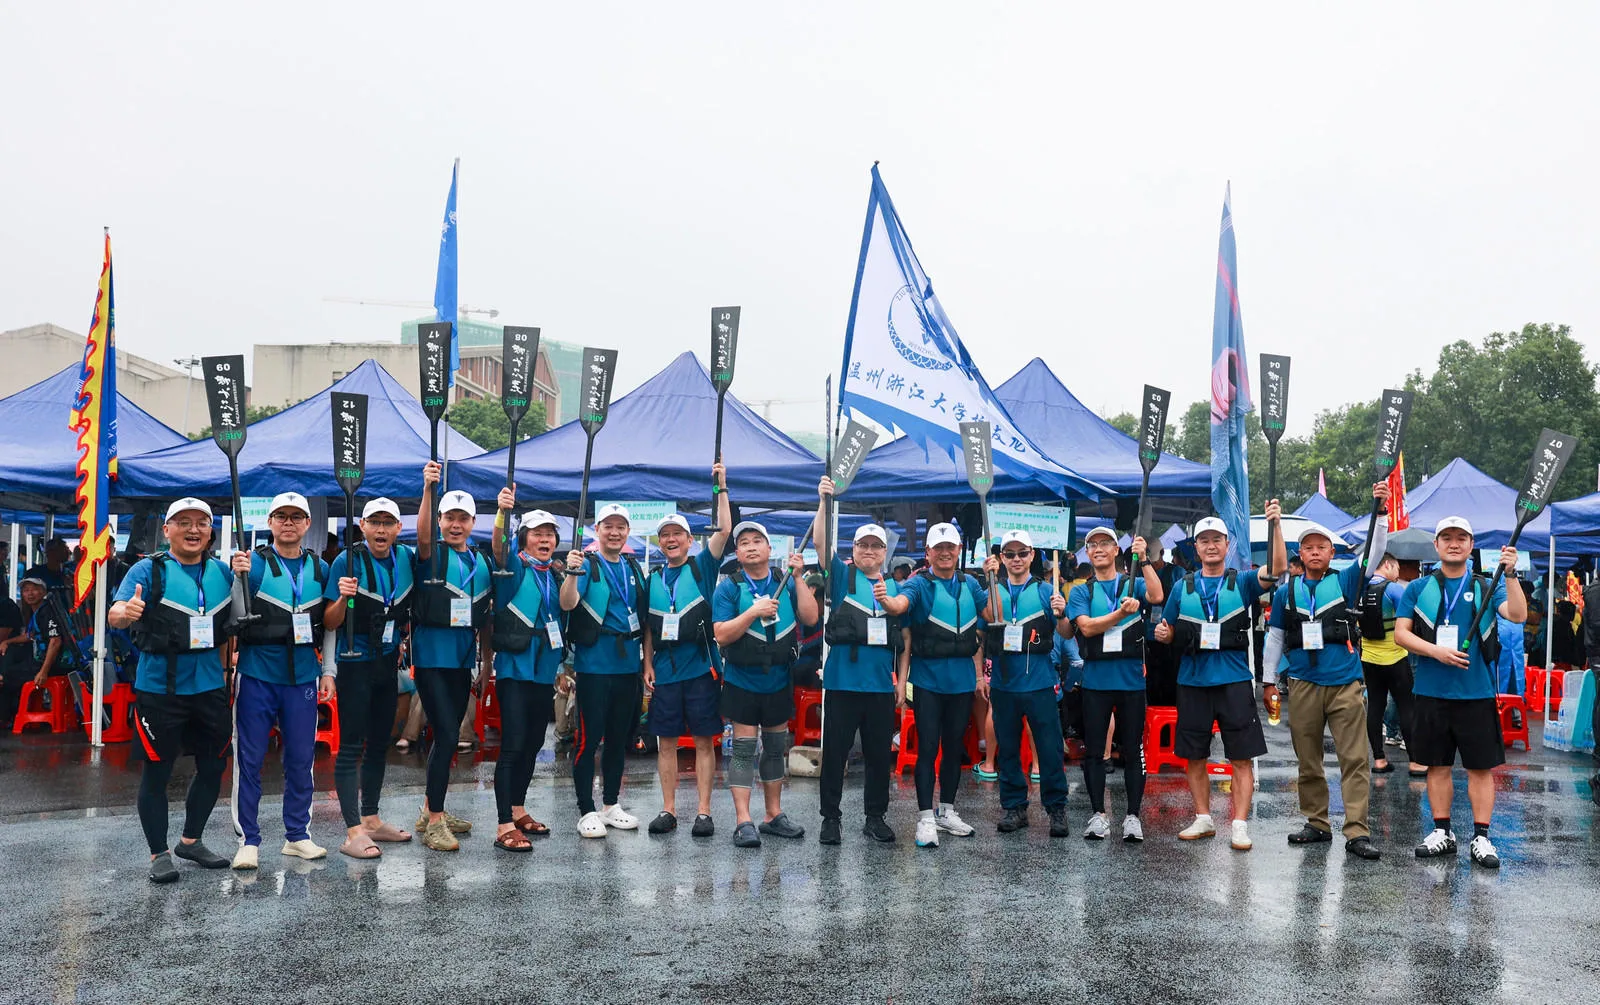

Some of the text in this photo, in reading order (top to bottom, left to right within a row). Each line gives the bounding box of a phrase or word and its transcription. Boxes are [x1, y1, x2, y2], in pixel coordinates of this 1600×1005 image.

[425, 398, 444, 406] AREX
[856, 430, 865, 438] 10
[1549, 440, 1562, 448] 07
[341, 469, 360, 477] AREX
[1540, 458, 1560, 498] ZHEJIANG UNIVERSITY
